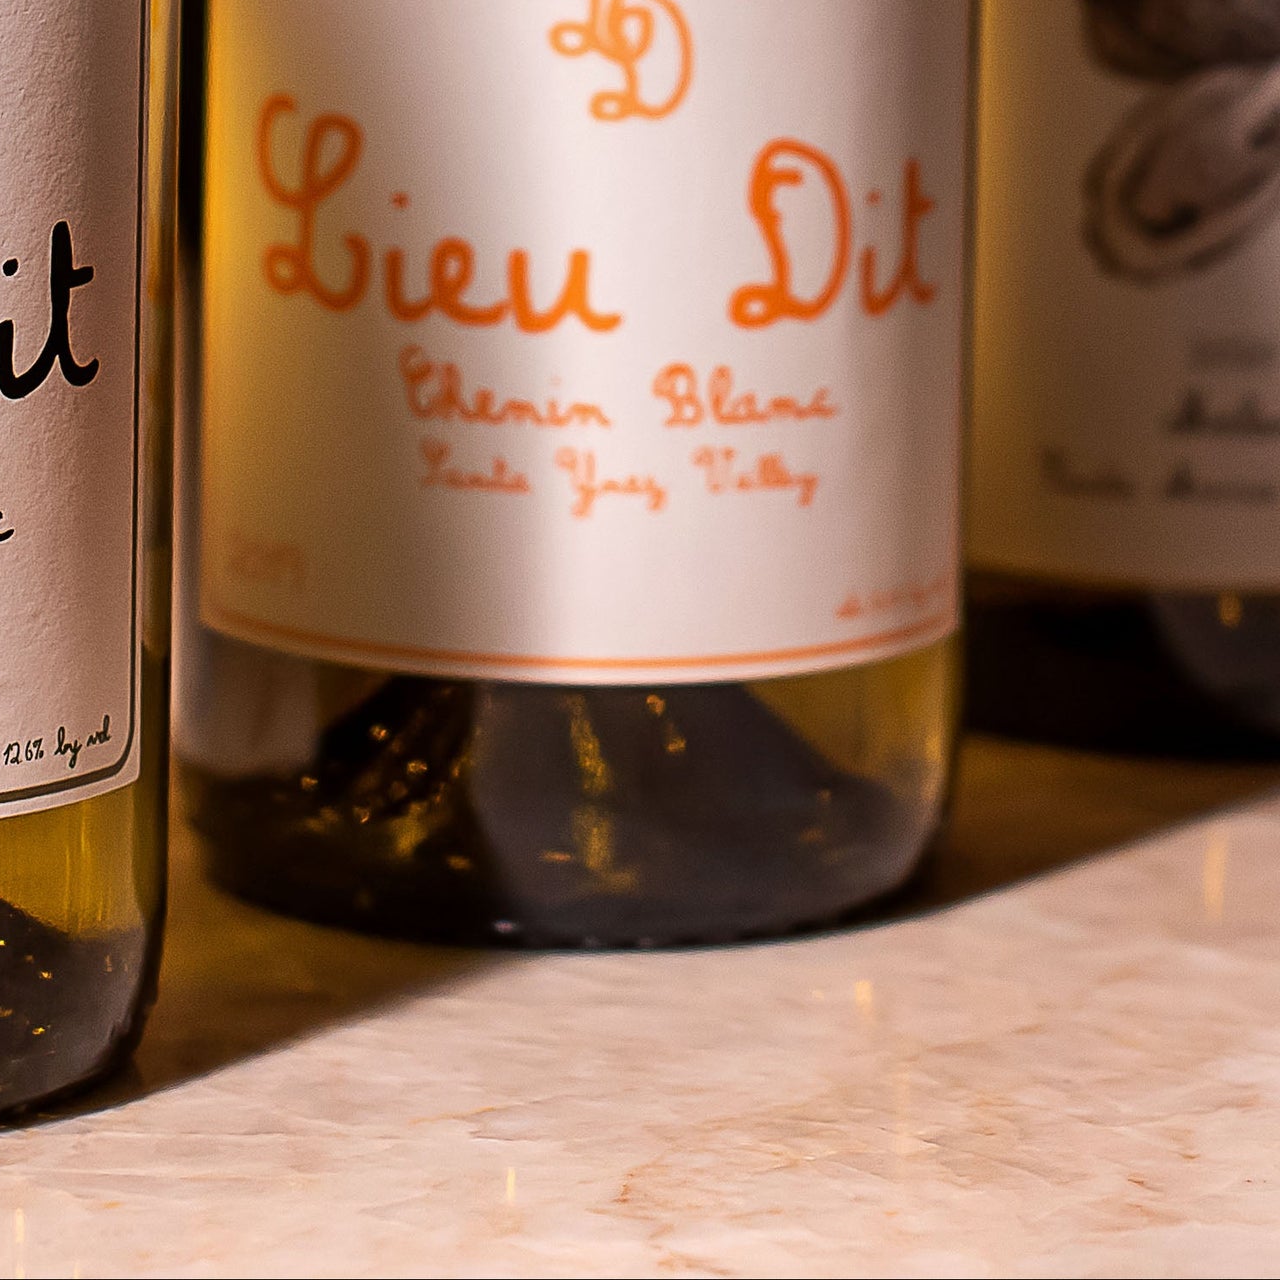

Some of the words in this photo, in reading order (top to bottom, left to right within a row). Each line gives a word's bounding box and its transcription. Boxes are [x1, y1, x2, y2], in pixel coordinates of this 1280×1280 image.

[255, 93, 623, 334] Lieu
[728, 137, 937, 331] Dit
[650, 361, 839, 428] Blanc
[53, 726, 83, 769] by
